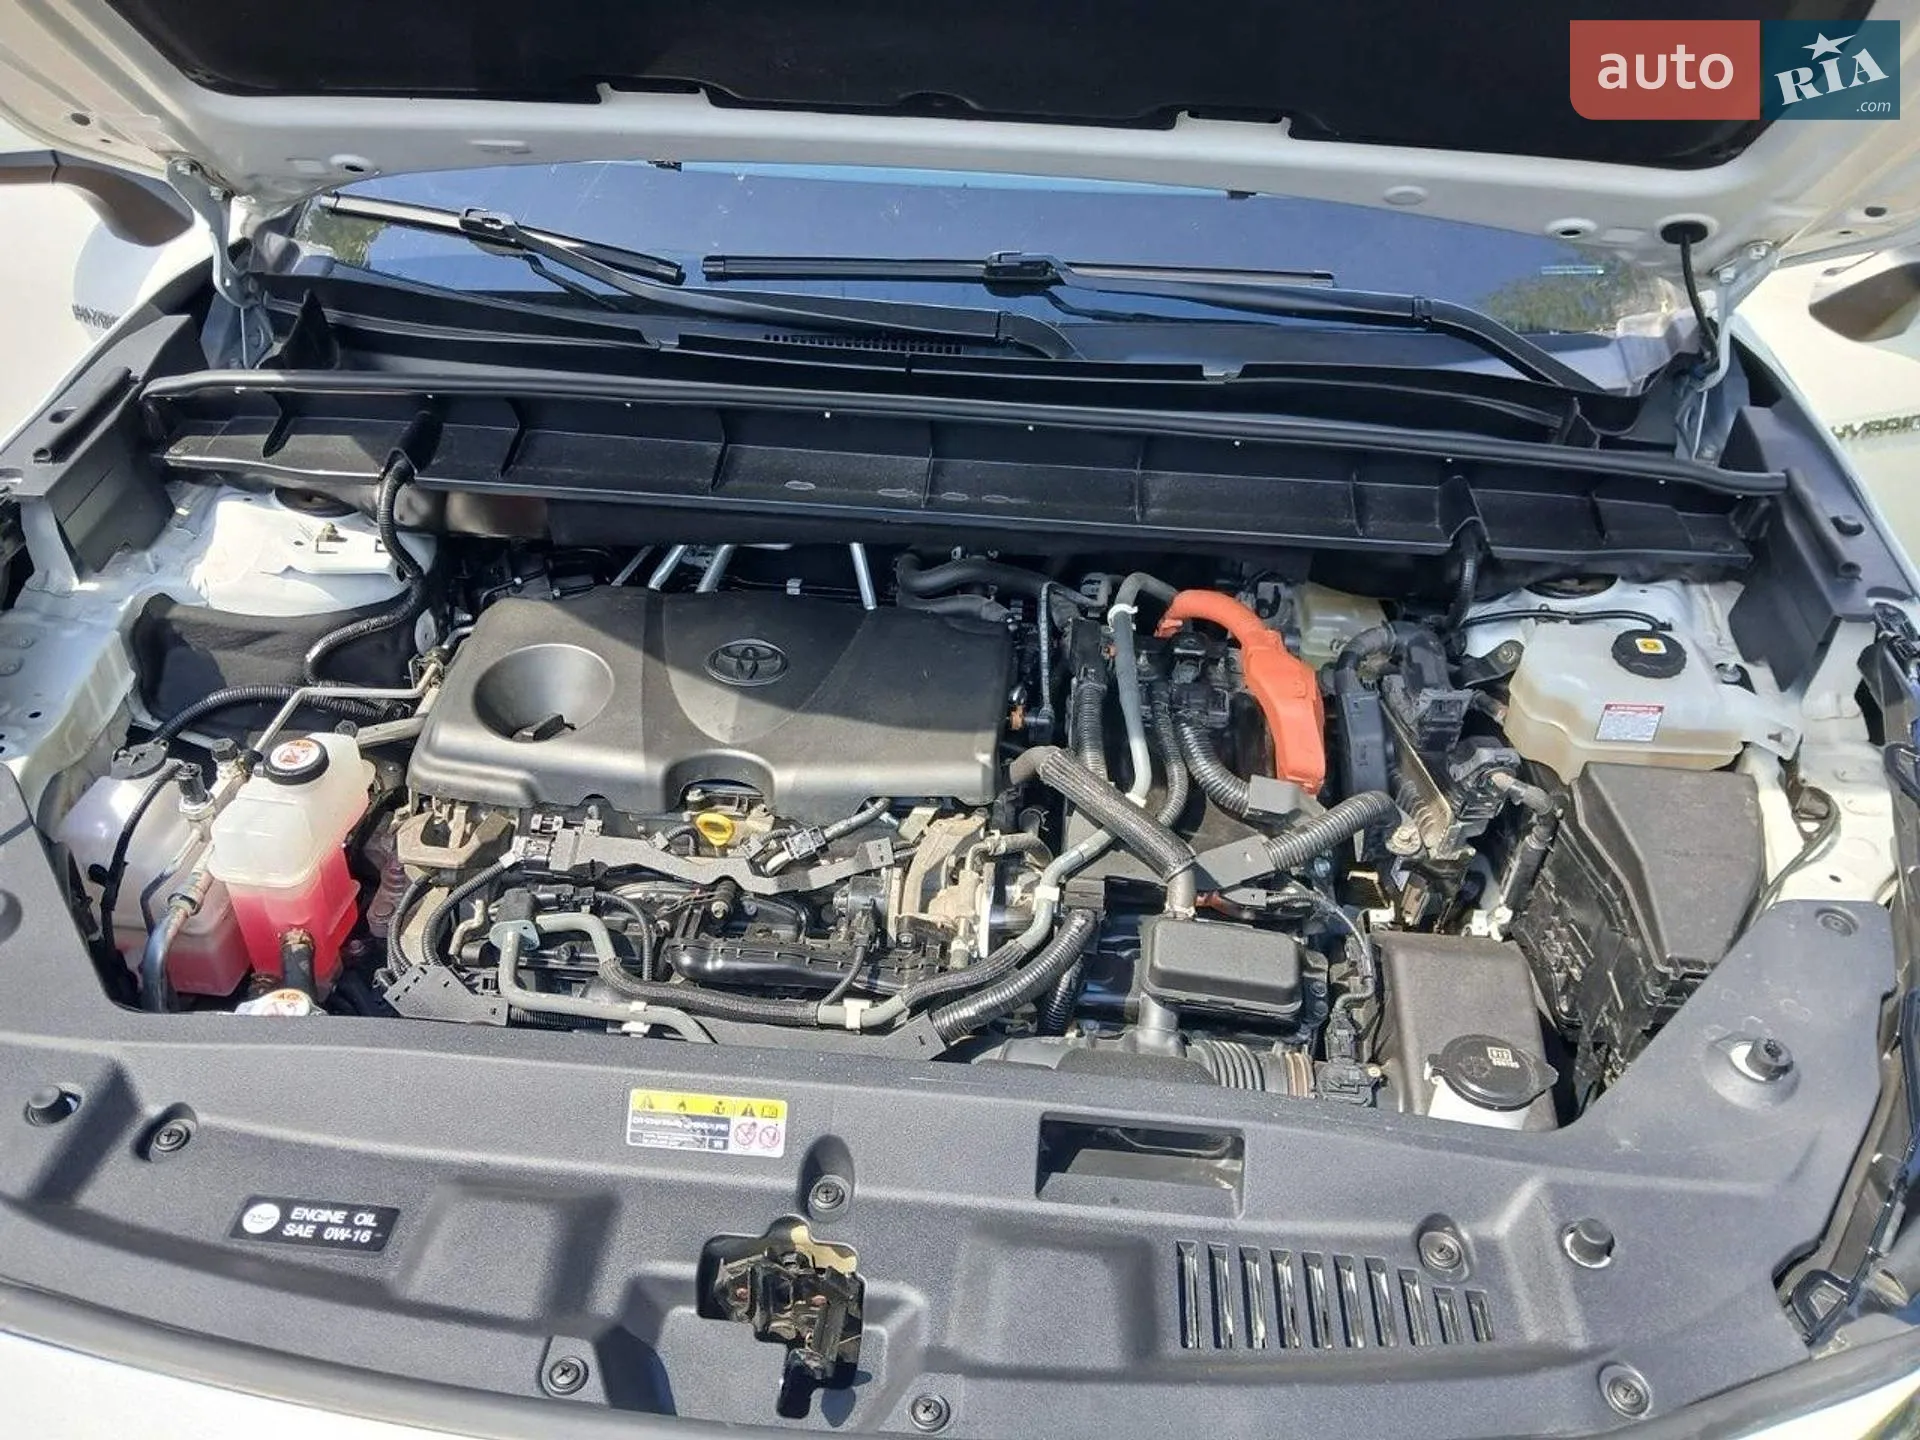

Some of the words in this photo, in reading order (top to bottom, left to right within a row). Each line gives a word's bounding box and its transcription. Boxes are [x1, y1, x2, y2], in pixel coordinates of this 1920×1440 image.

[290, 1206, 348, 1224] ENGINE
[354, 1212, 378, 1227] OIL
[281, 1222, 316, 1238] SAE
